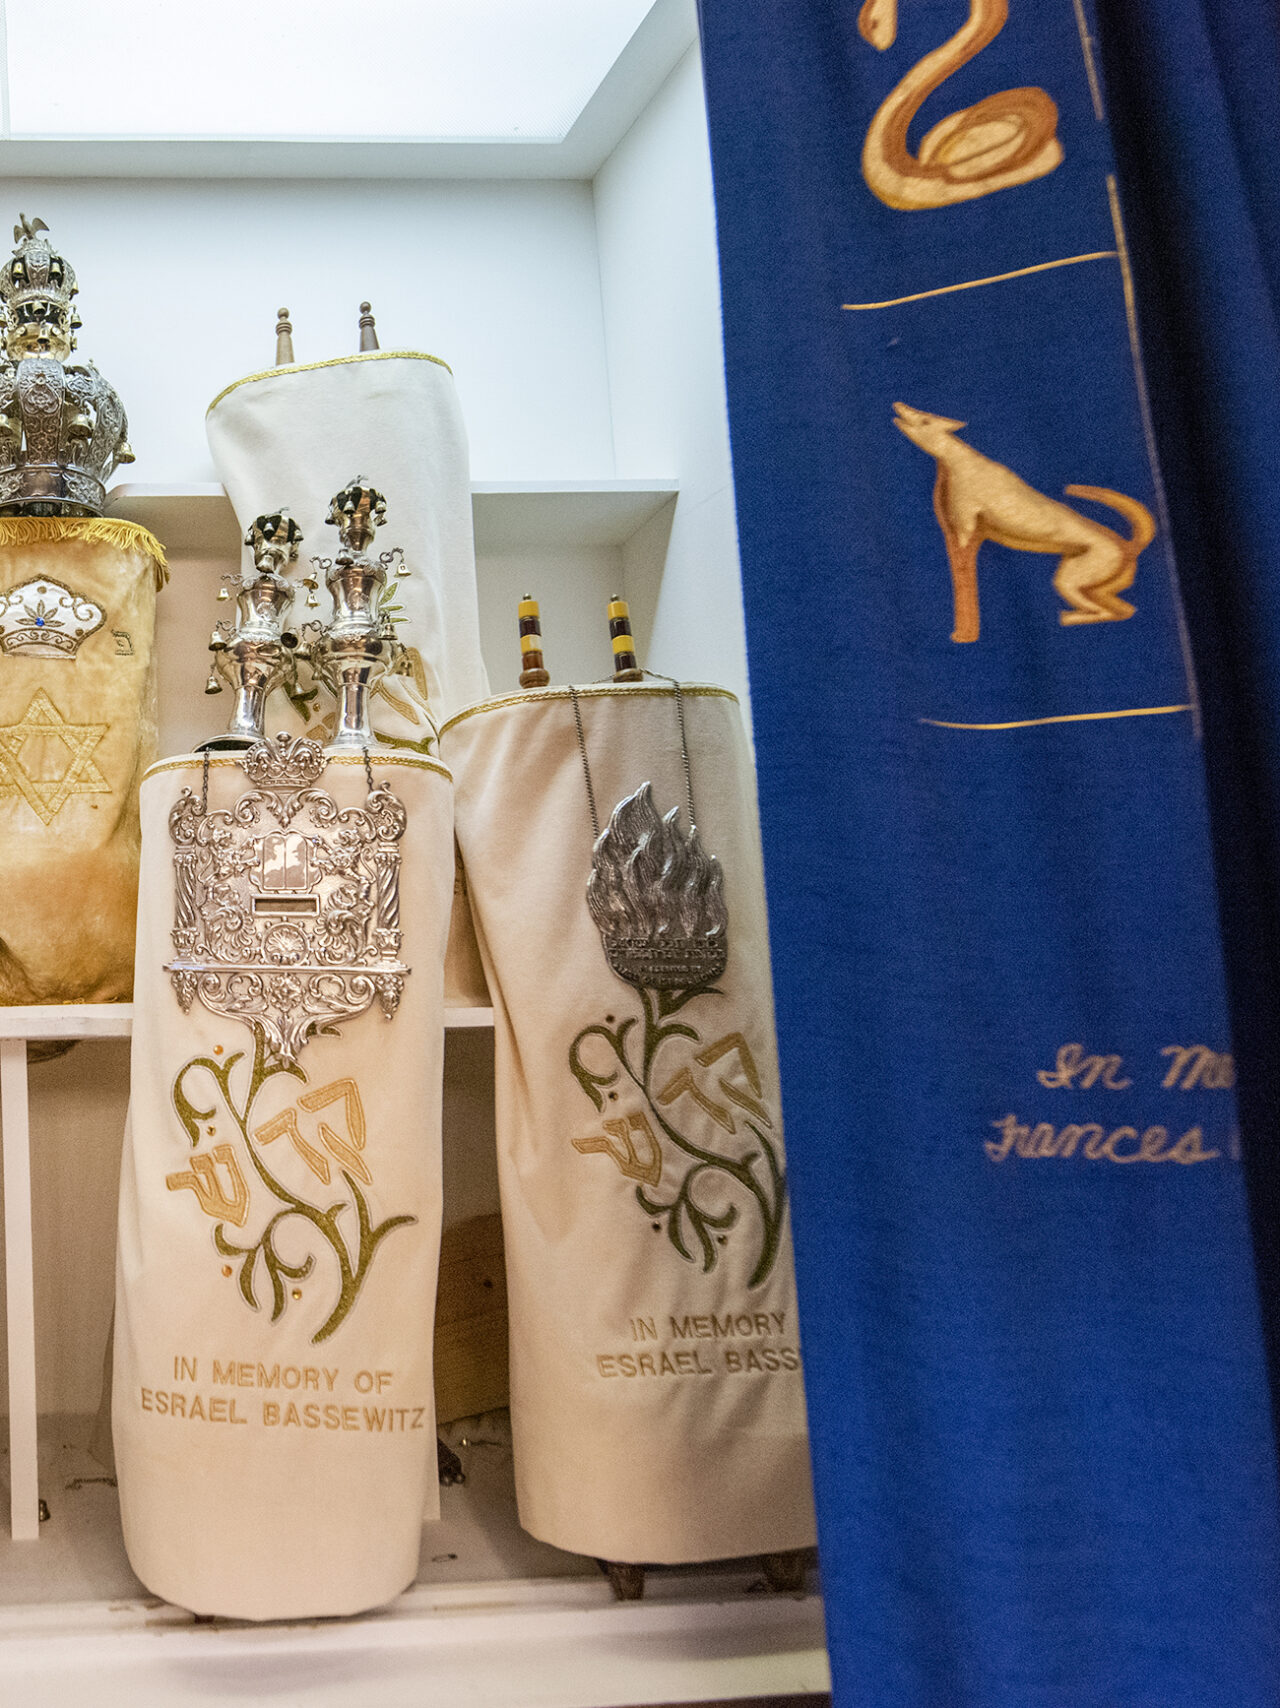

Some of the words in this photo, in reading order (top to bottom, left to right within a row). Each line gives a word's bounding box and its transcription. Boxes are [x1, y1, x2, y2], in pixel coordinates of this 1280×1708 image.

[1036, 1043, 1132, 1090] In
[630, 1315, 659, 1342] IN
[670, 1311, 786, 1340] MEMORY
[173, 1355, 198, 1383] IN
[212, 1360, 340, 1393] MEMORY
[353, 1370, 394, 1395] OF
[596, 1350, 714, 1379] ESRAEL
[725, 1347, 800, 1375] BASS
[140, 1386, 248, 1425] ESRAEL
[262, 1401, 426, 1433] BASSEWITZ
